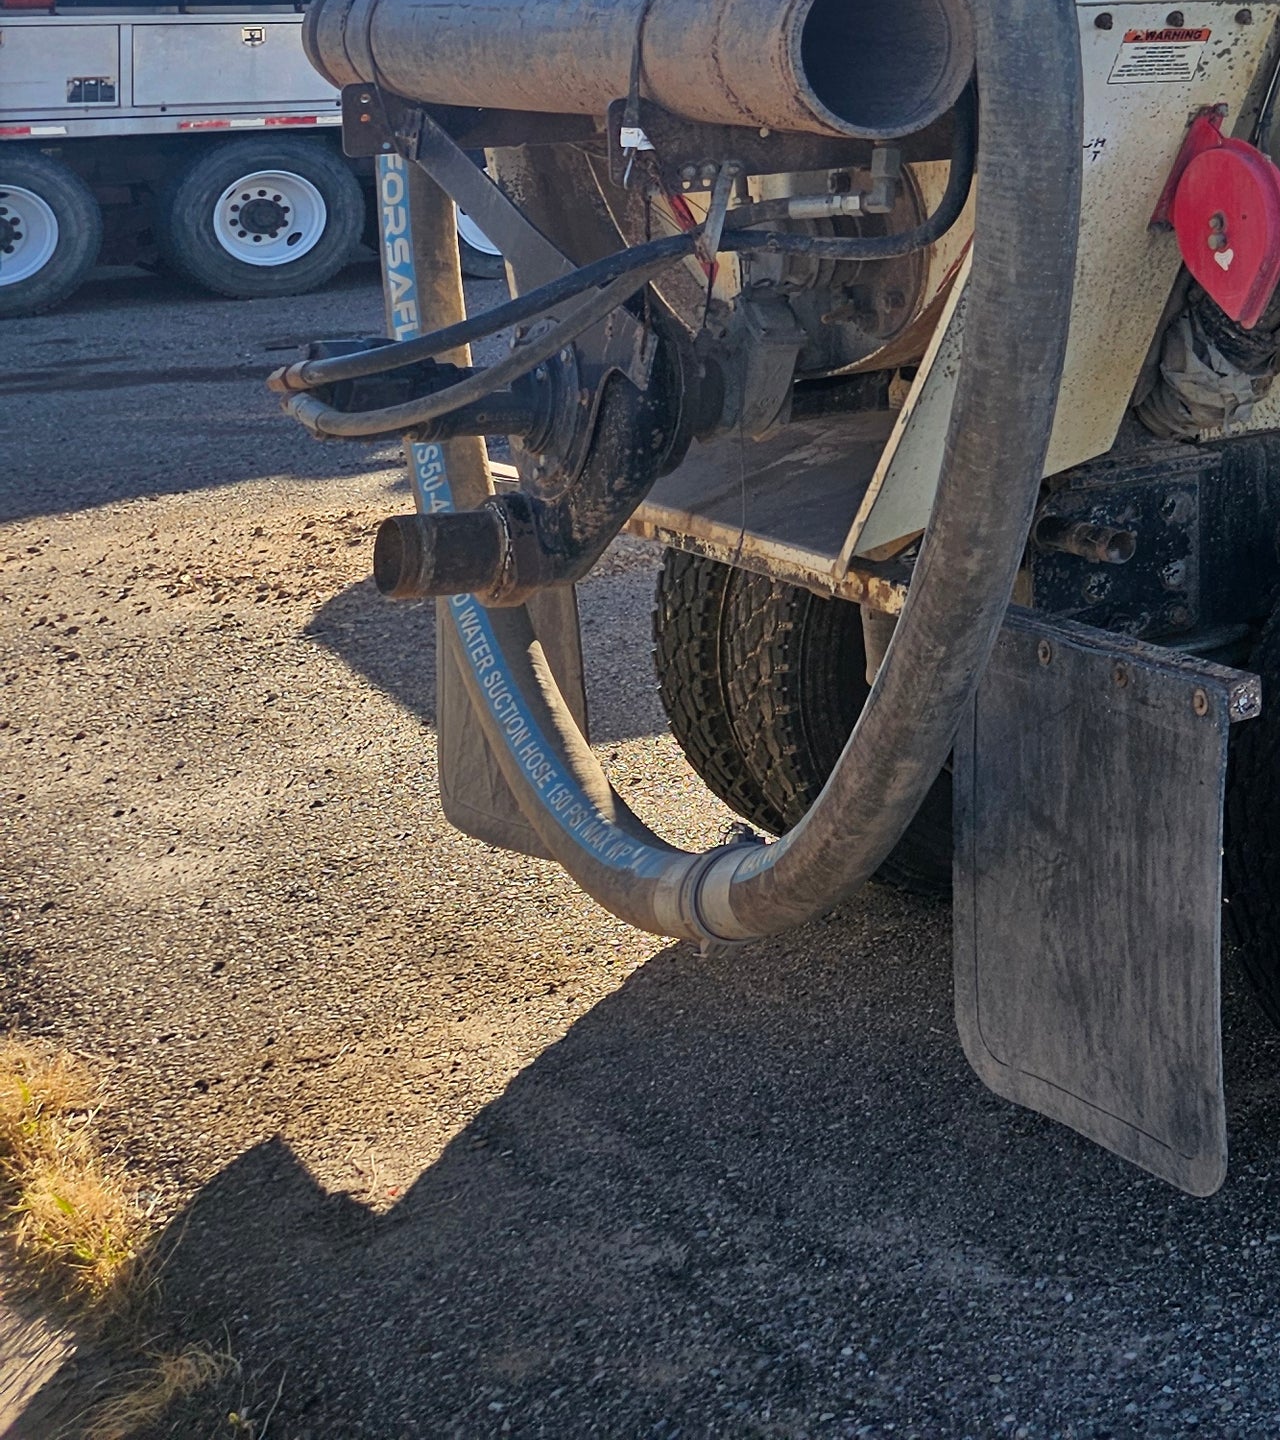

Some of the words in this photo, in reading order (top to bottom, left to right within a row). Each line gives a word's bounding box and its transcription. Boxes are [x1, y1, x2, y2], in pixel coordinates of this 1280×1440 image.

[1145, 29, 1203, 41] WARNING
[414, 443, 454, 513] S50-4
[459, 610, 496, 675] WATER
[483, 672, 532, 747] SUCTION
[522, 737, 558, 789] HOSE
[548, 783, 574, 811] 150
[562, 803, 592, 831] PSI
[579, 821, 617, 853] MAX
